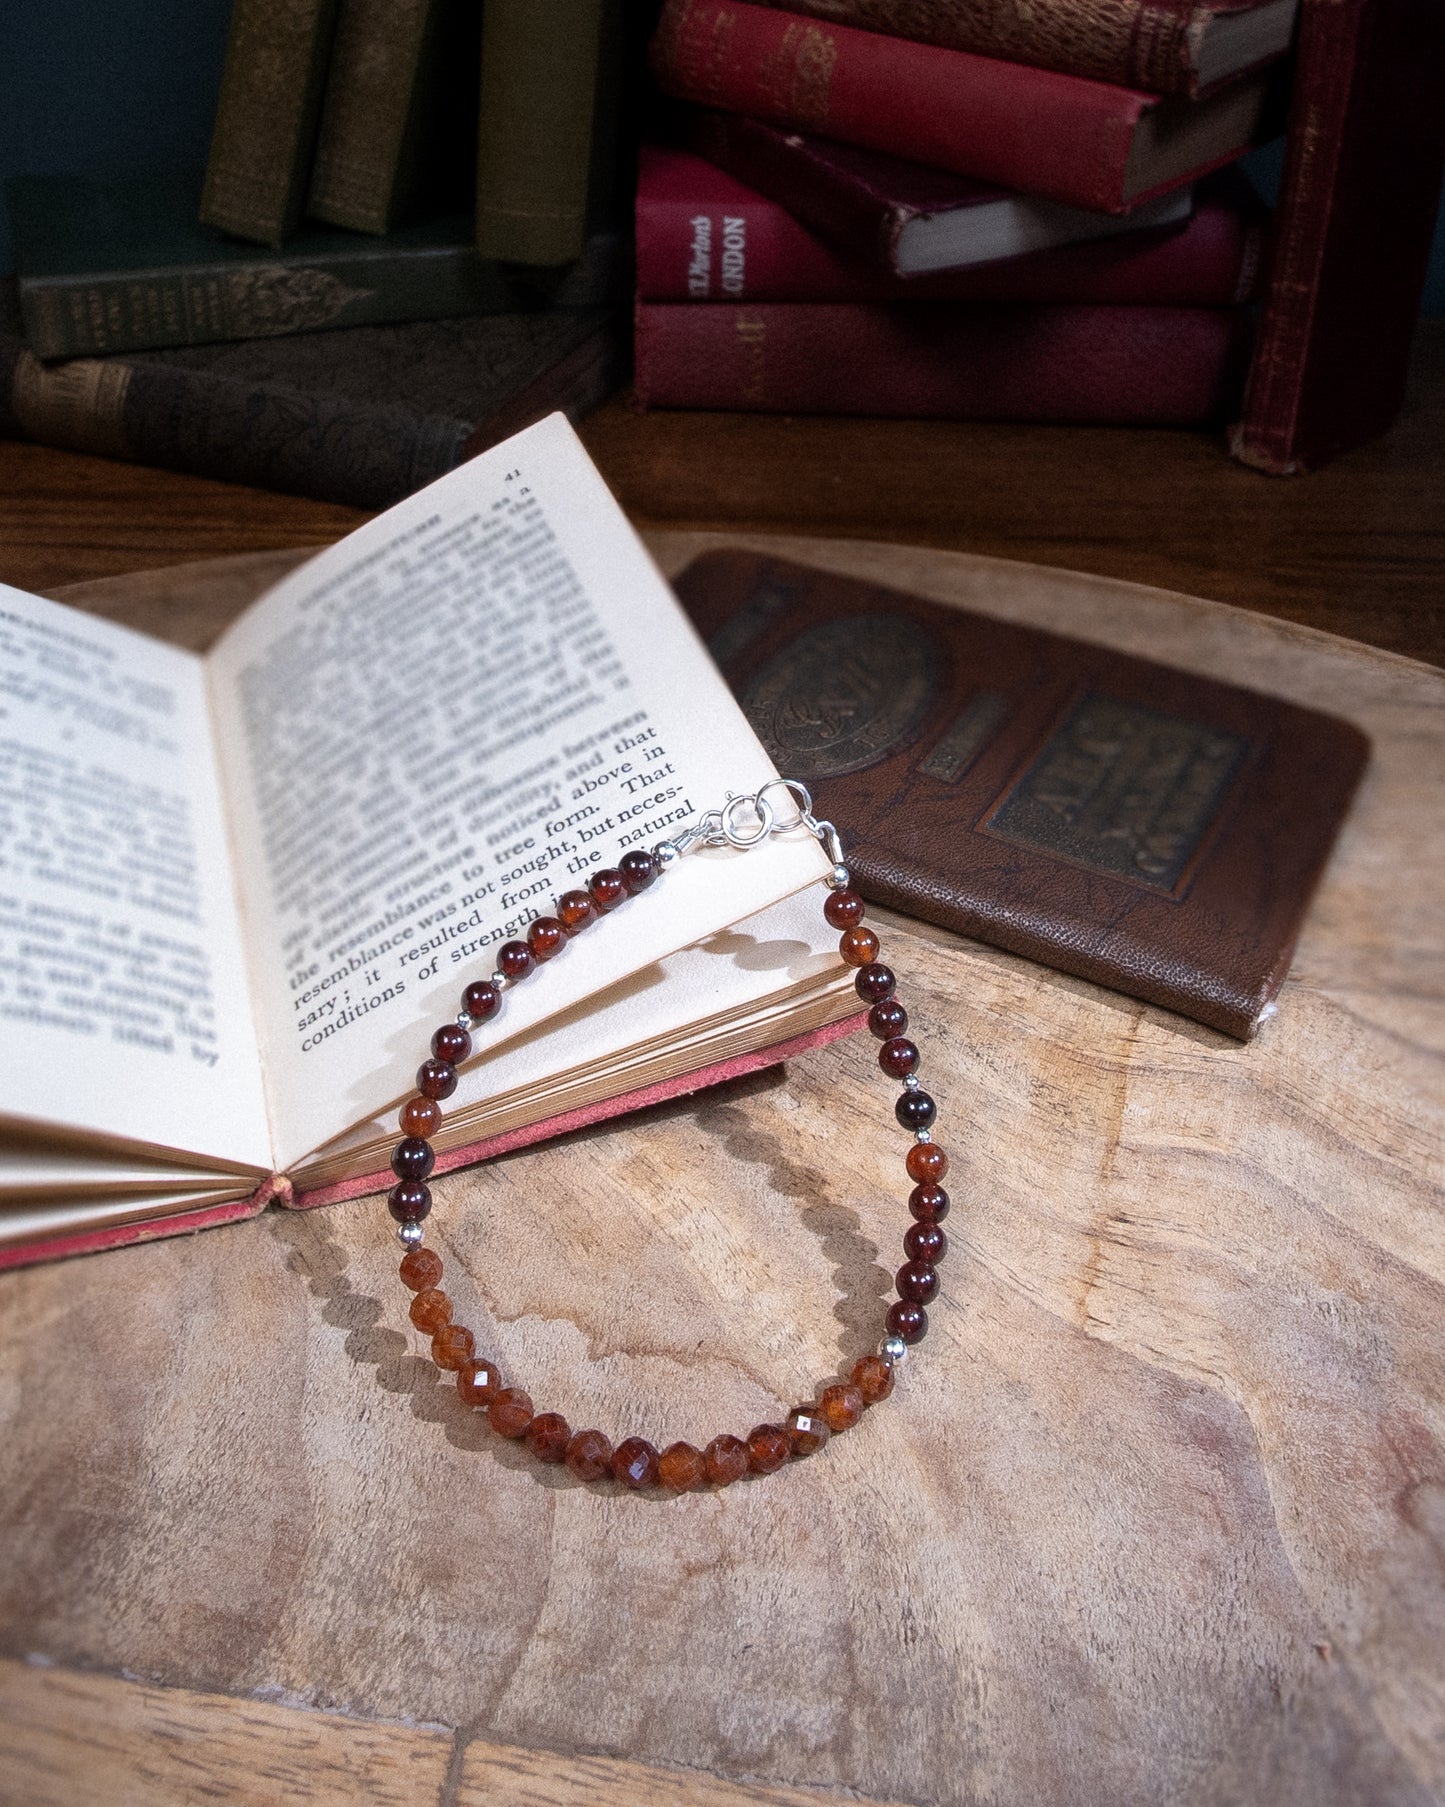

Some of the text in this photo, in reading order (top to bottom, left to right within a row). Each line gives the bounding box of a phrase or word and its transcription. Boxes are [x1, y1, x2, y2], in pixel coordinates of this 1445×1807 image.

[504, 468, 521, 481] 41
[520, 486, 531, 496] a
[387, 846, 475, 902] structure
[486, 795, 563, 847] noticed
[571, 762, 633, 801] above
[641, 746, 666, 762] in
[565, 751, 605, 782] and
[613, 727, 658, 755] that
[289, 762, 676, 991] the resemblance to tree form. That
[293, 927, 414, 1012] resemblance
[417, 903, 458, 930] was
[460, 881, 496, 908] not
[500, 840, 578, 887] sought,
[576, 817, 616, 844] but
[616, 785, 684, 824] neces-
[365, 969, 382, 987] it
[398, 909, 484, 968] resulted
[500, 877, 553, 910] from
[566, 850, 602, 875] the
[617, 798, 696, 849] natural
[301, 980, 406, 1053] conditions
[417, 955, 439, 981] of
[450, 907, 541, 963] strength
